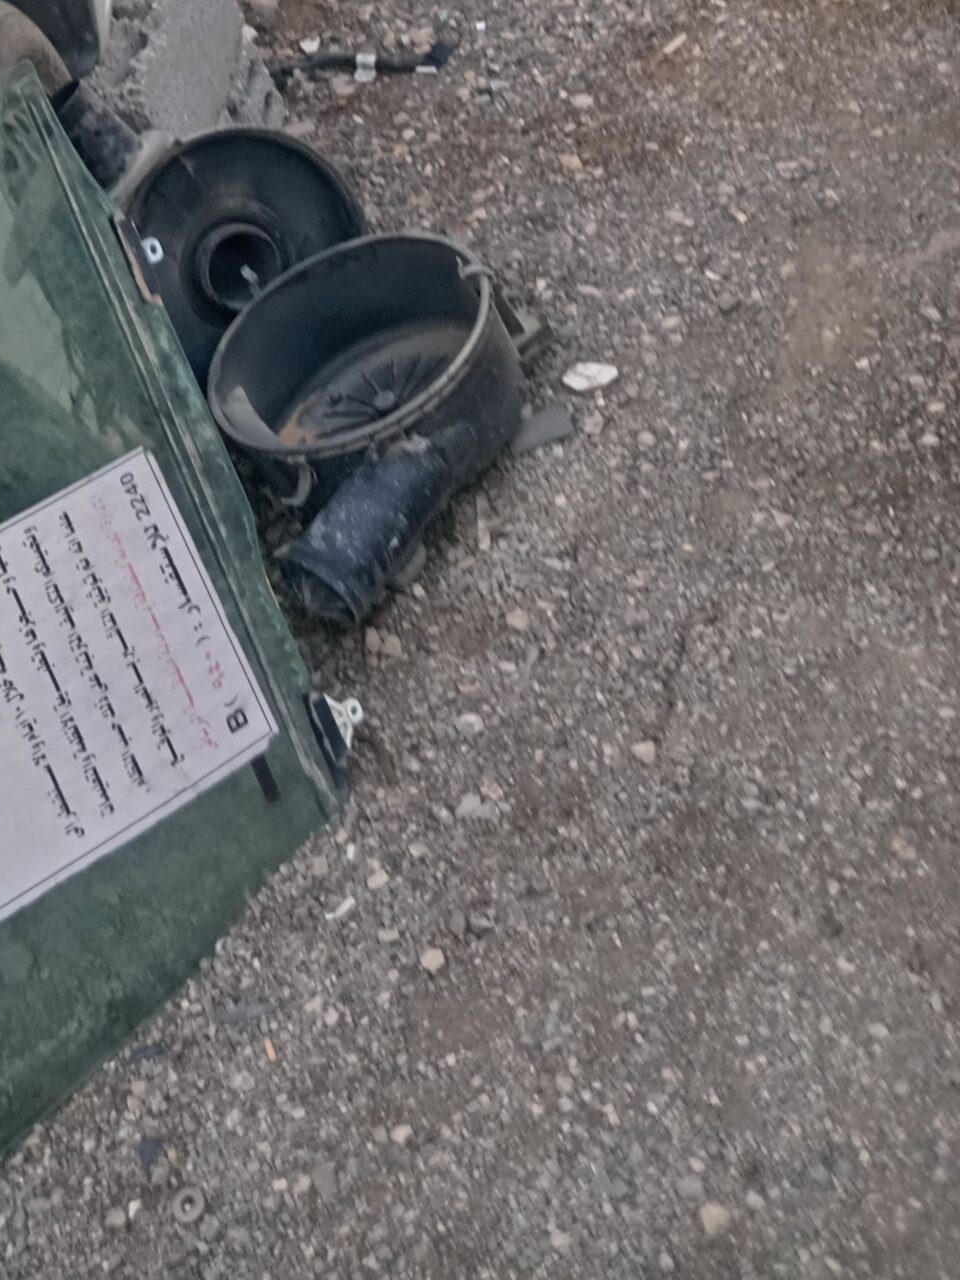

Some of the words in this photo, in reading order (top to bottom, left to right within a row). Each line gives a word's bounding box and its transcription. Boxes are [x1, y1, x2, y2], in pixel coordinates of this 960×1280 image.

[20, 524, 56, 579] وتحميلكم
[42, 575, 77, 632] التكاليف
[65, 629, 96, 678] المترتبة
[92, 693, 117, 720] ذلك
[109, 720, 133, 750] حسب
[74, 555, 96, 572] تم
[80, 569, 112, 609] توثيق
[118, 470, 152, 523] 2240
[224, 703, 250, 736] B
[1, 574, 39, 646] وحجزها
[29, 640, 73, 714] وتطبيق
[80, 751, 116, 819] والتعليمات
